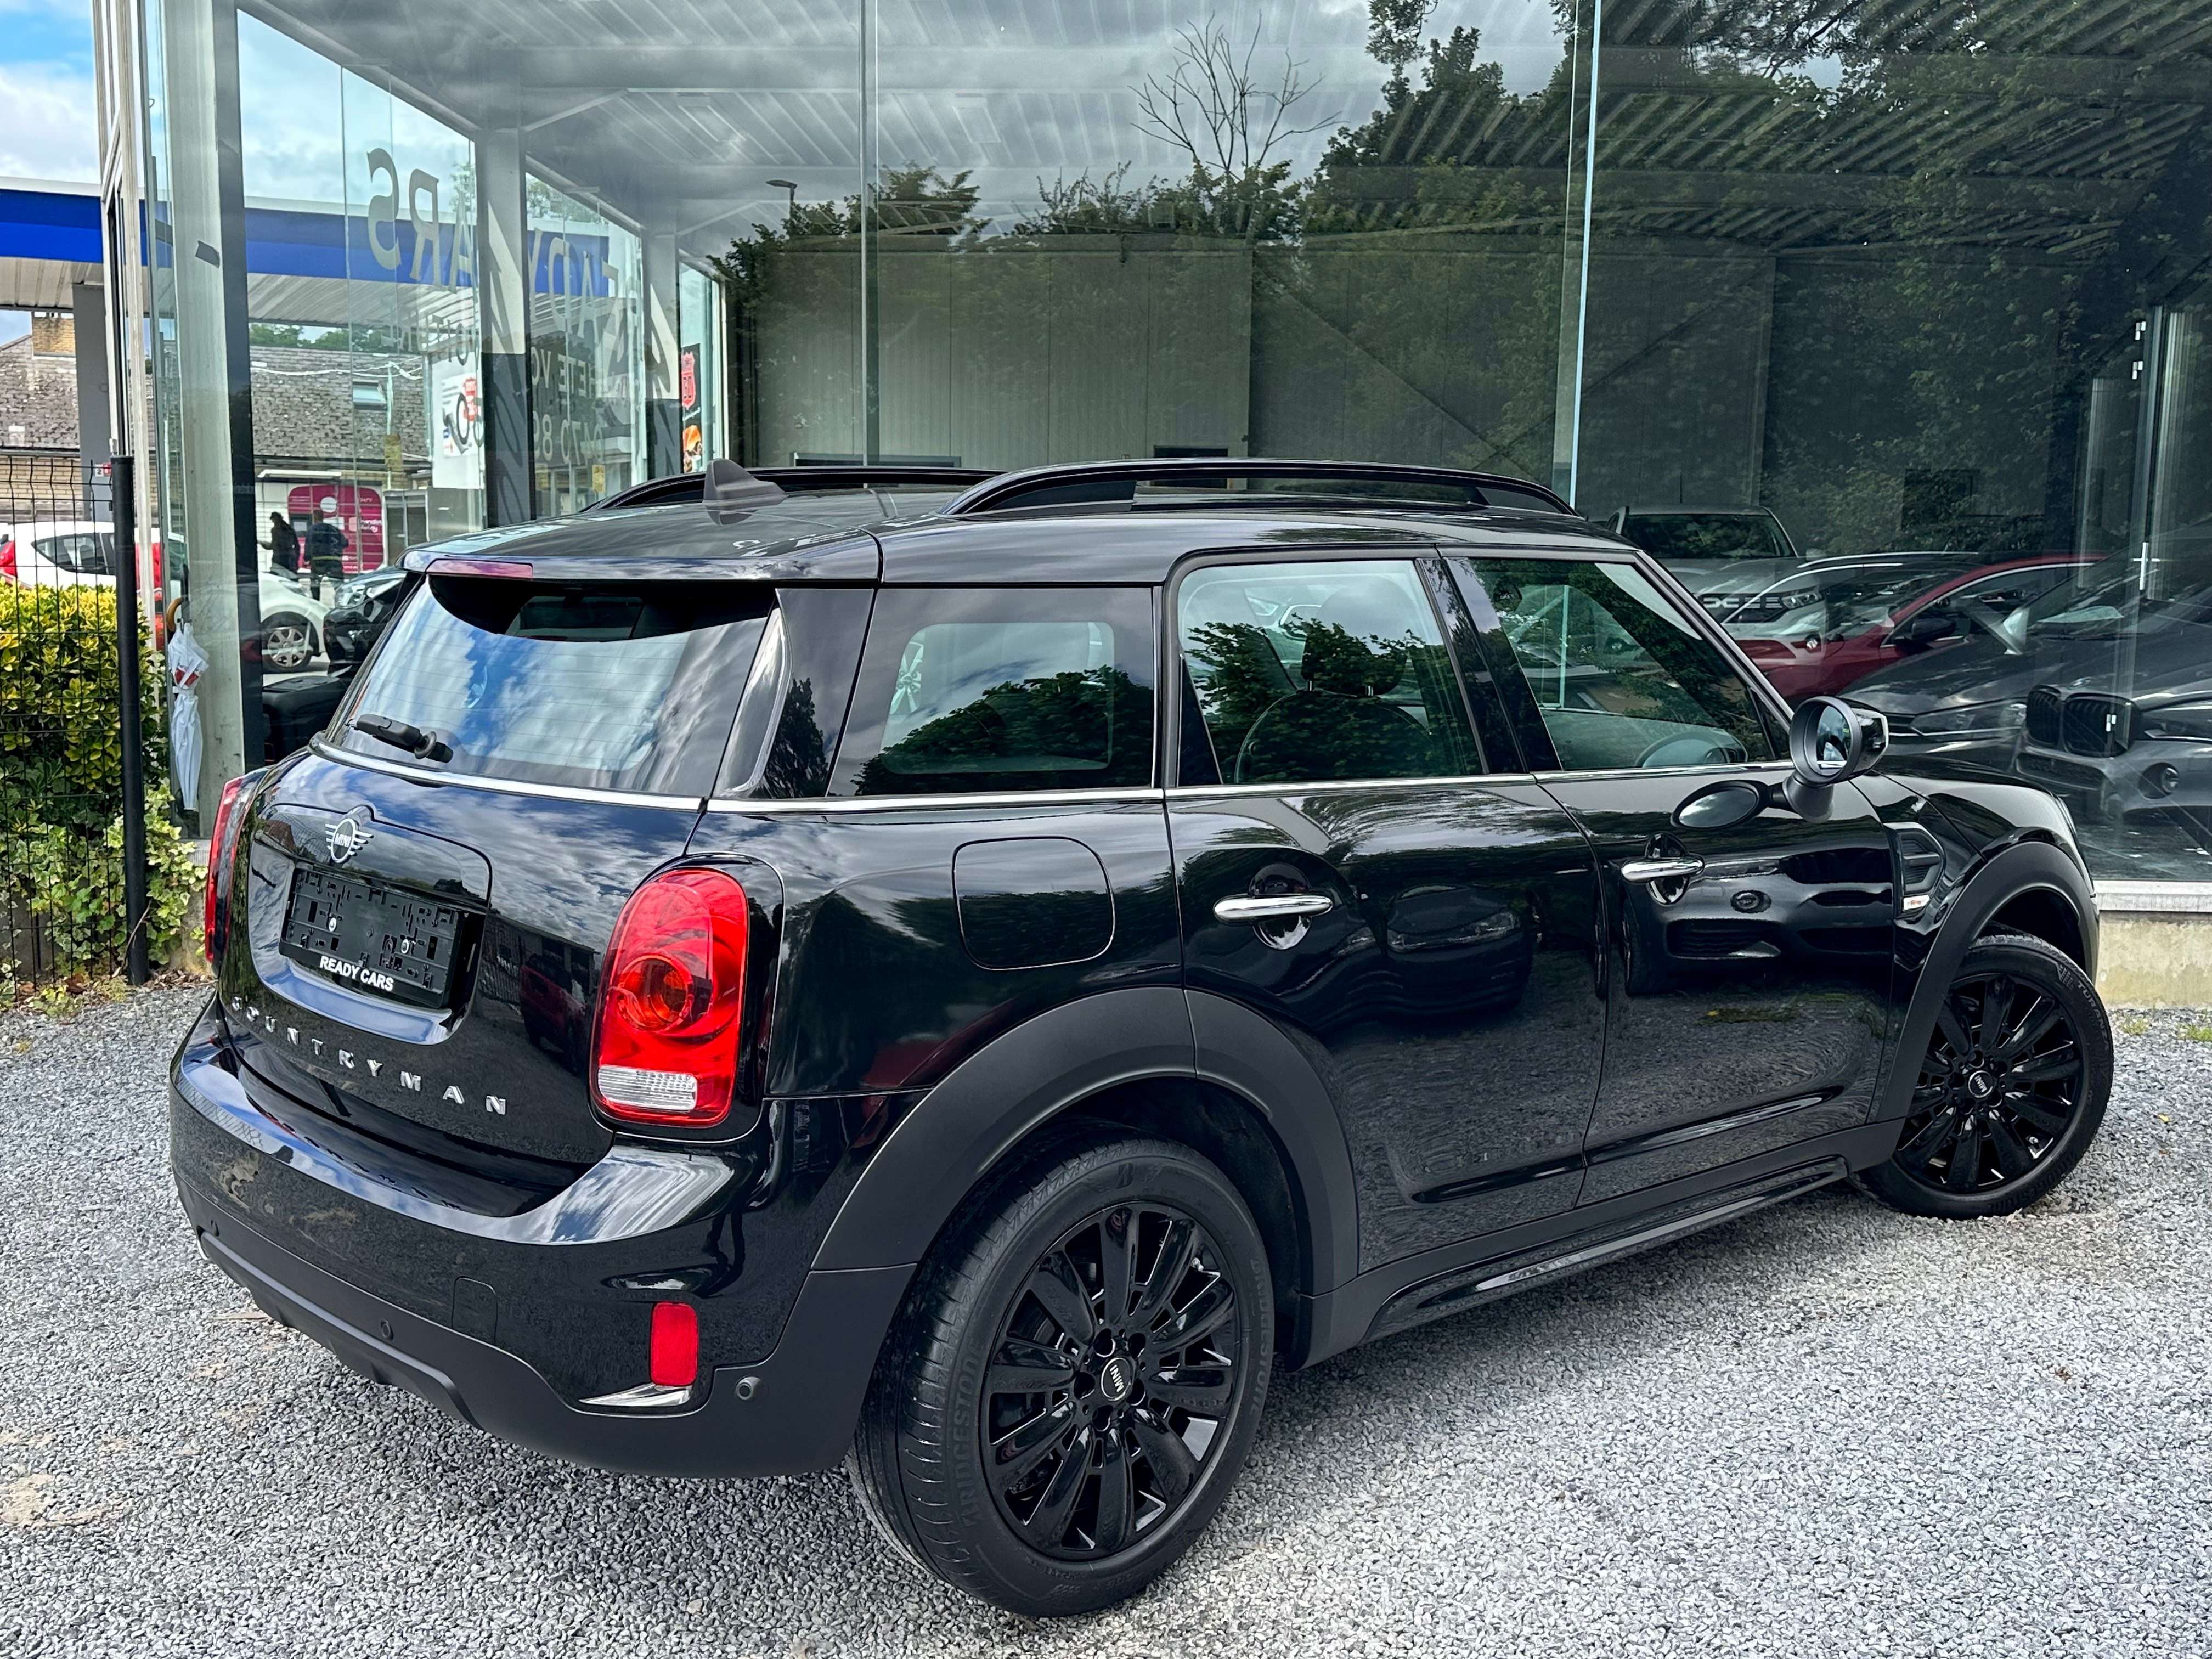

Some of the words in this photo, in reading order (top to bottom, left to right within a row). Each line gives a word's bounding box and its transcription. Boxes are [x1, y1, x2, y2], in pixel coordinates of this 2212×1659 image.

[334, 832, 352, 848] MINI
[319, 955, 360, 979] READY
[360, 969, 394, 991] CARS
[232, 996, 507, 1115] COUNTRYMAN
[1974, 1075, 1988, 1093] MINI
[1109, 1364, 1125, 1393] MINI
